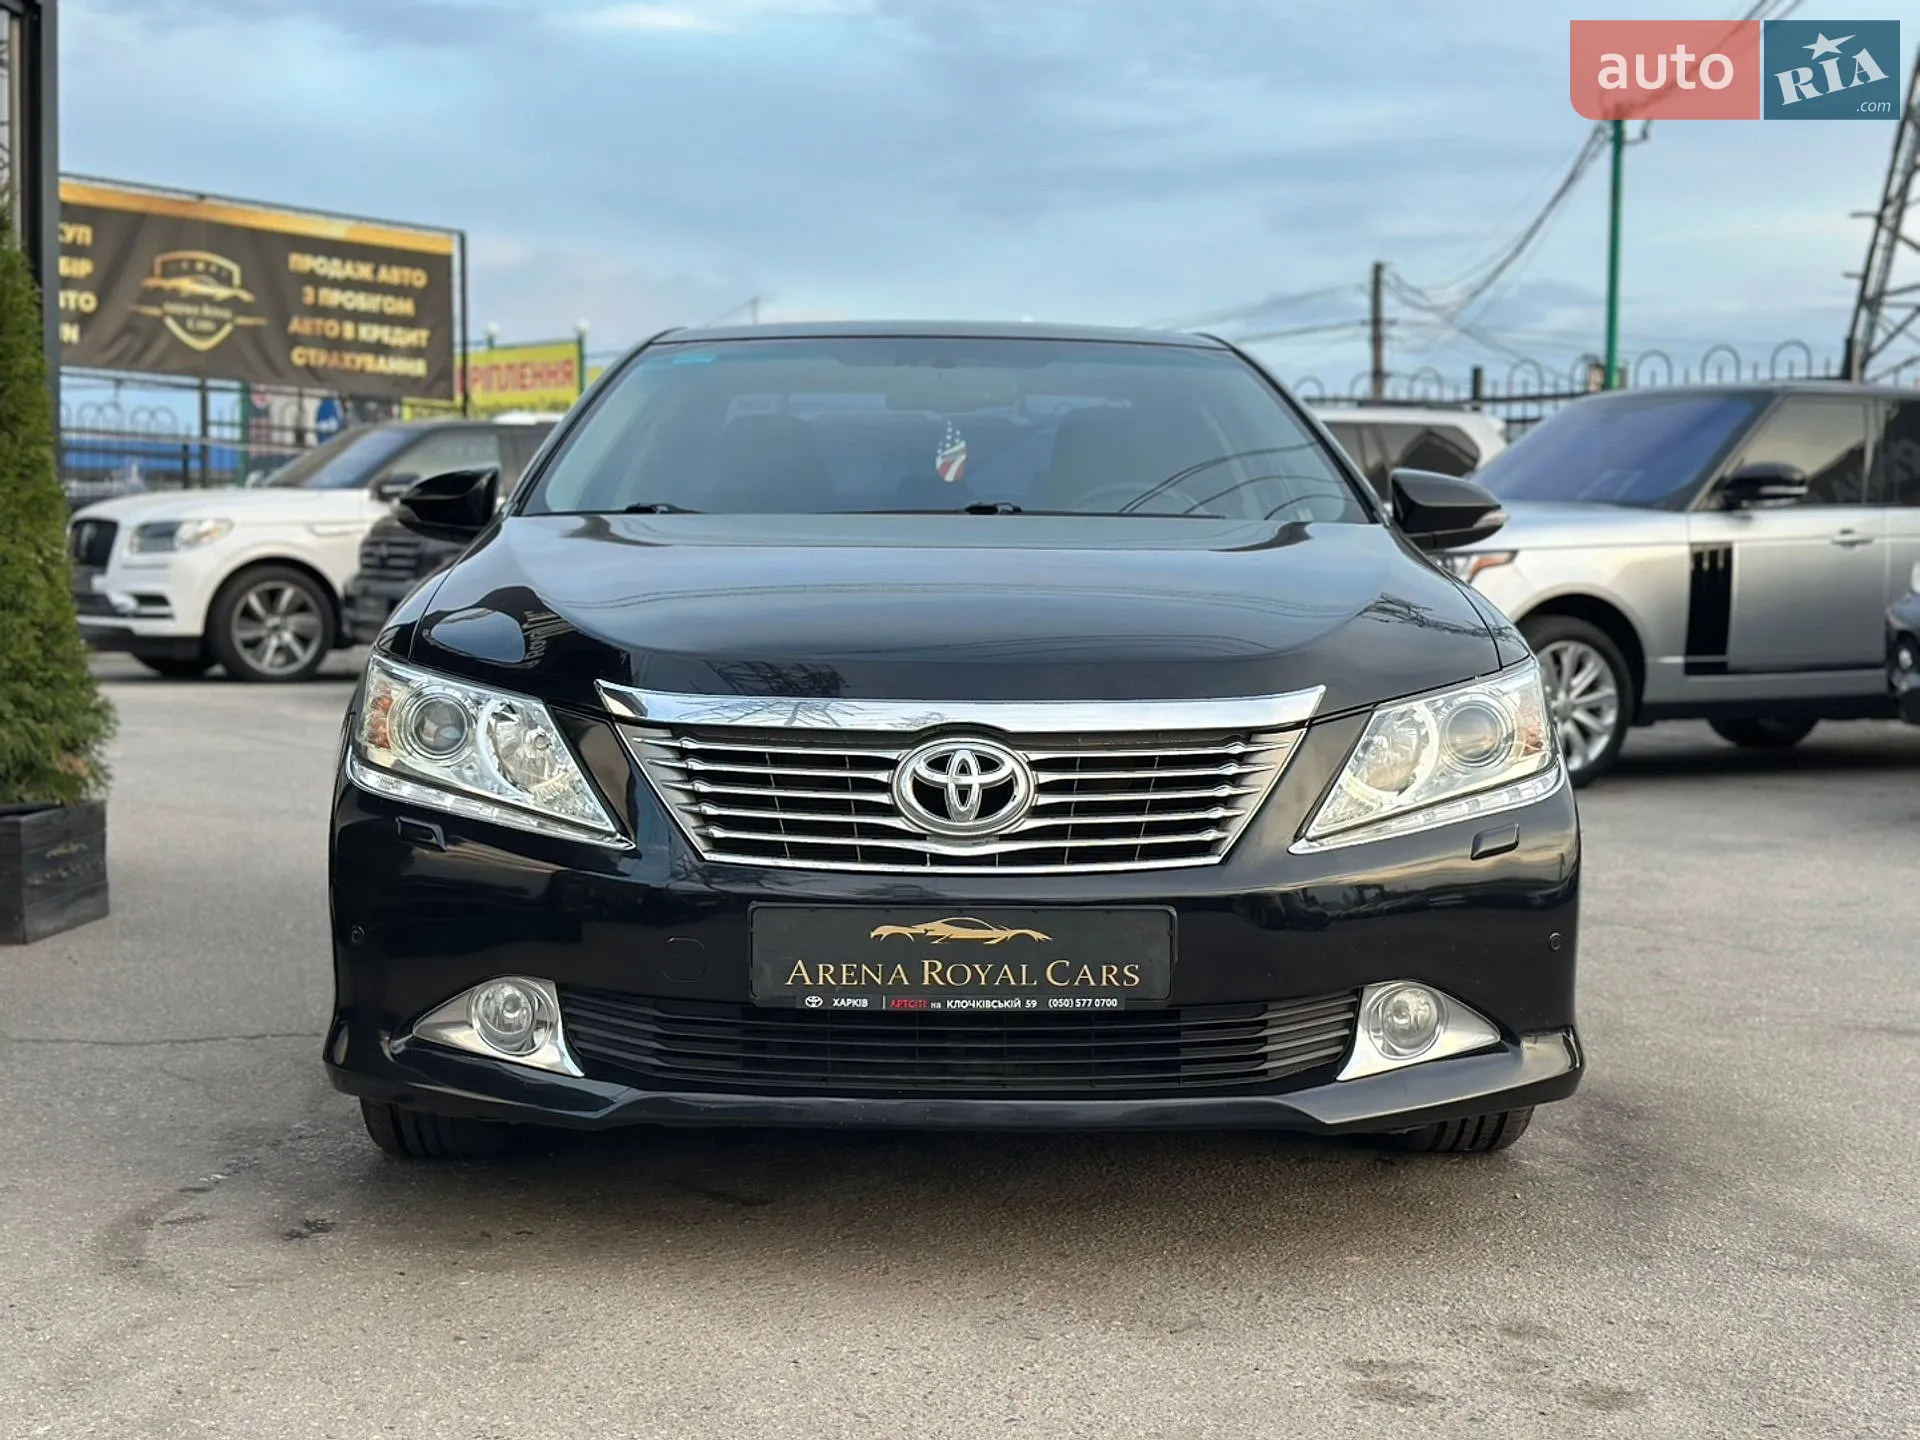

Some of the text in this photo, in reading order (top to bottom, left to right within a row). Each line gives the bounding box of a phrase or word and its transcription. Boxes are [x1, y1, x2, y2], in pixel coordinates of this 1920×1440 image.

[288, 252, 428, 289] ПРОДАЖ АВТО
[318, 287, 416, 317] ПРОБІГОМ
[287, 314, 431, 349] АВТО В КРЕДИТ
[290, 345, 428, 378] СТРАХУВАННЯ
[784, 959, 1141, 987] ARENA ROYAL CARS
[832, 998, 869, 1008] ХАРКІВ
[930, 1001, 942, 1009] на
[946, 998, 1021, 1009] КЛОЧКІВСЬКІЙ
[1025, 999, 1037, 1009] 59
[1048, 998, 1073, 1009] (050)
[1075, 998, 1091, 1008] 577
[1094, 998, 1118, 1008] 0700
